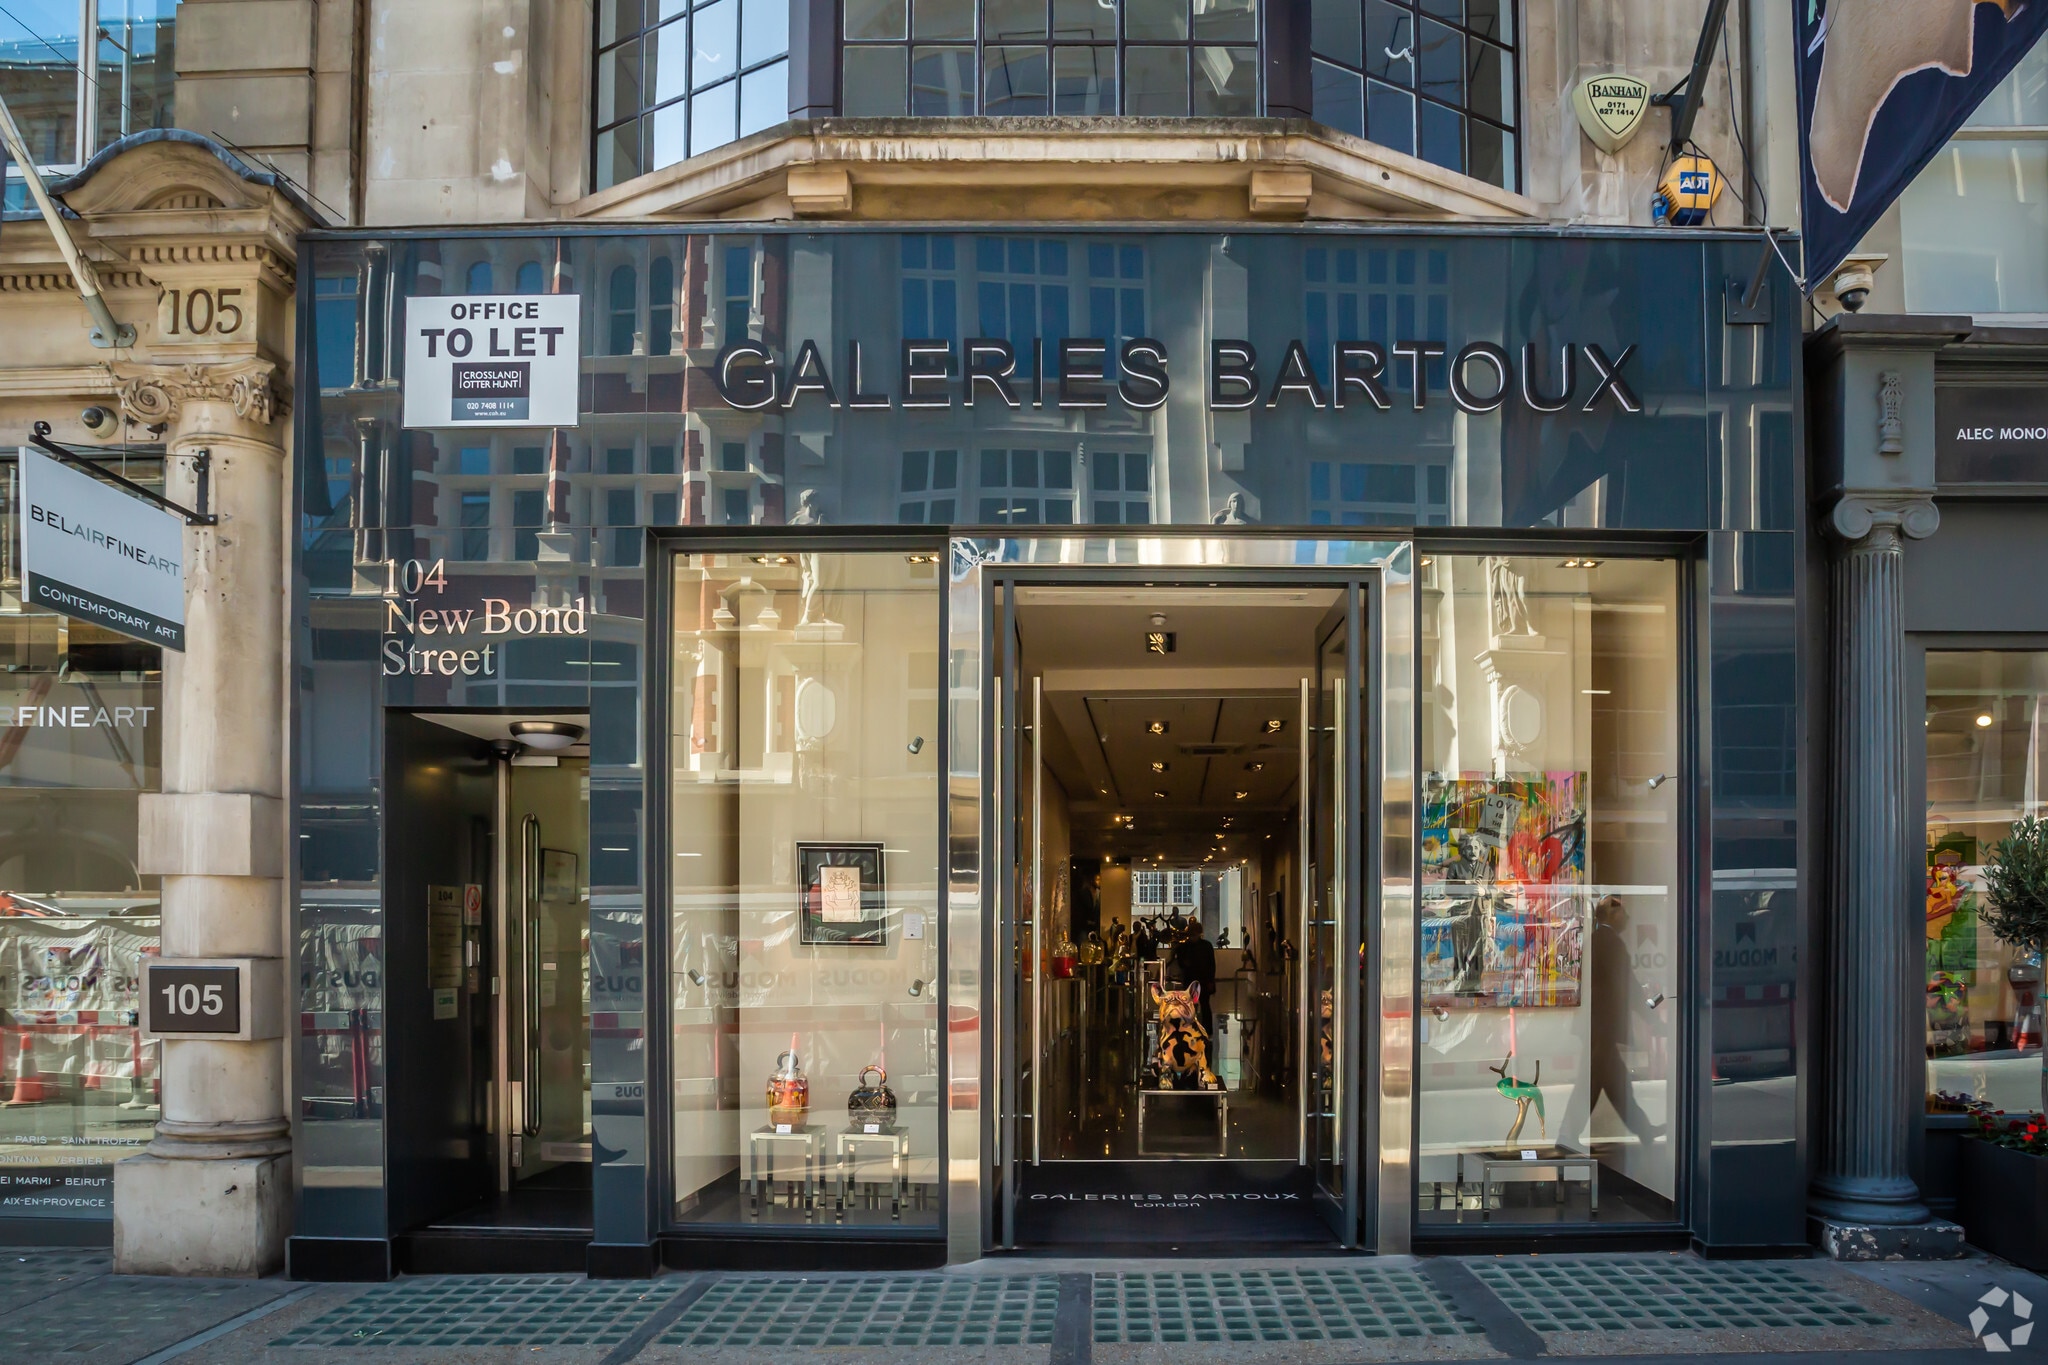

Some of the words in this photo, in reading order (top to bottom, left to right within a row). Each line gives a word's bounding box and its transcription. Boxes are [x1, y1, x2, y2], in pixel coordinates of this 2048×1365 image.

[1592, 85, 1642, 97] BANHAM
[1680, 175, 1709, 190] ADT
[167, 288, 243, 335] 105
[450, 302, 539, 320] OFFICE
[420, 327, 473, 358] TO
[489, 327, 564, 357] LET
[462, 371, 519, 380] CROSSLAND
[714, 337, 1170, 412] GALERIES
[1209, 338, 1642, 415] BARTOUX
[462, 380, 490, 389] OTTER
[492, 380, 518, 389] HUNT
[466, 402, 479, 410] 020
[1956, 428, 1994, 440] ALEC
[1999, 427, 2048, 440] MONO
[31, 504, 180, 577] BELAIRFINEART
[383, 558, 448, 597] 104
[39, 585, 151, 631] CONTEMPORARY
[155, 624, 178, 640] ART
[383, 598, 474, 635] New
[481, 596, 588, 635] Bond
[383, 639, 496, 676] Street
[162, 984, 223, 1016] 105
[15, 1135, 48, 1144] PARIS
[61, 1136, 141, 1146] SAINT-TROPEZ
[54, 1156, 103, 1165] VERBIER
[15, 1176, 51, 1185] MARMI
[65, 1177, 107, 1187] BEIRUT
[3, 1197, 106, 1207] AIX-EN-PROVENCE
[1030, 1193, 1162, 1201] GALERIES
[1173, 1192, 1300, 1200] BARTOUX
